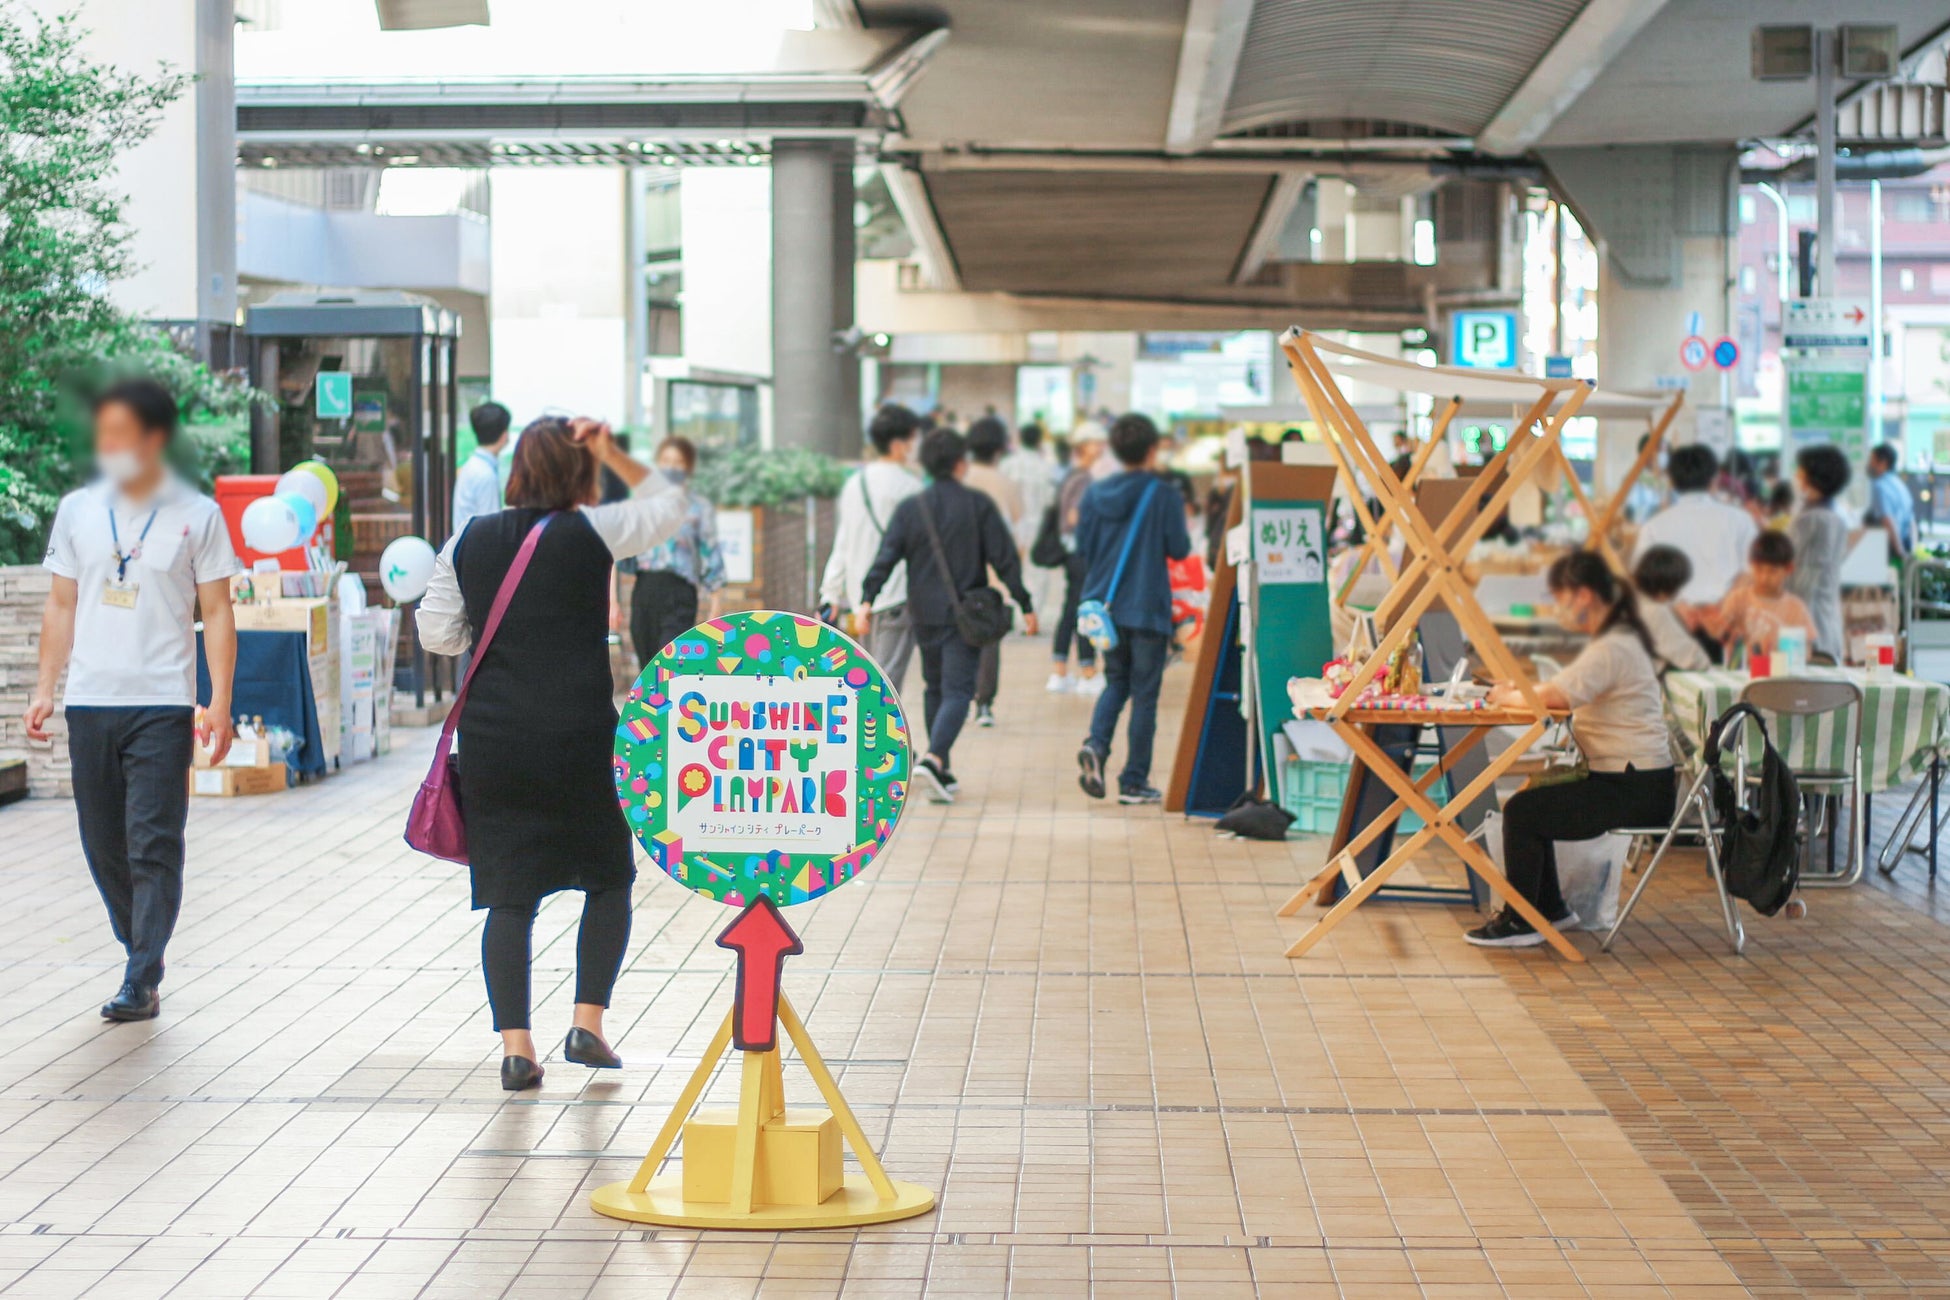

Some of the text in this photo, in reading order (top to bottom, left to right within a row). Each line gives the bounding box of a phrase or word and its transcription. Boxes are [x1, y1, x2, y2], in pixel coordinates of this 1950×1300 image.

[1473, 322, 1497, 353] P
[1261, 518, 1312, 548] ぬりえ
[677, 691, 848, 743] SUNSHINE
[707, 735, 818, 773] CITY
[774, 823, 822, 836] プレーパーク
